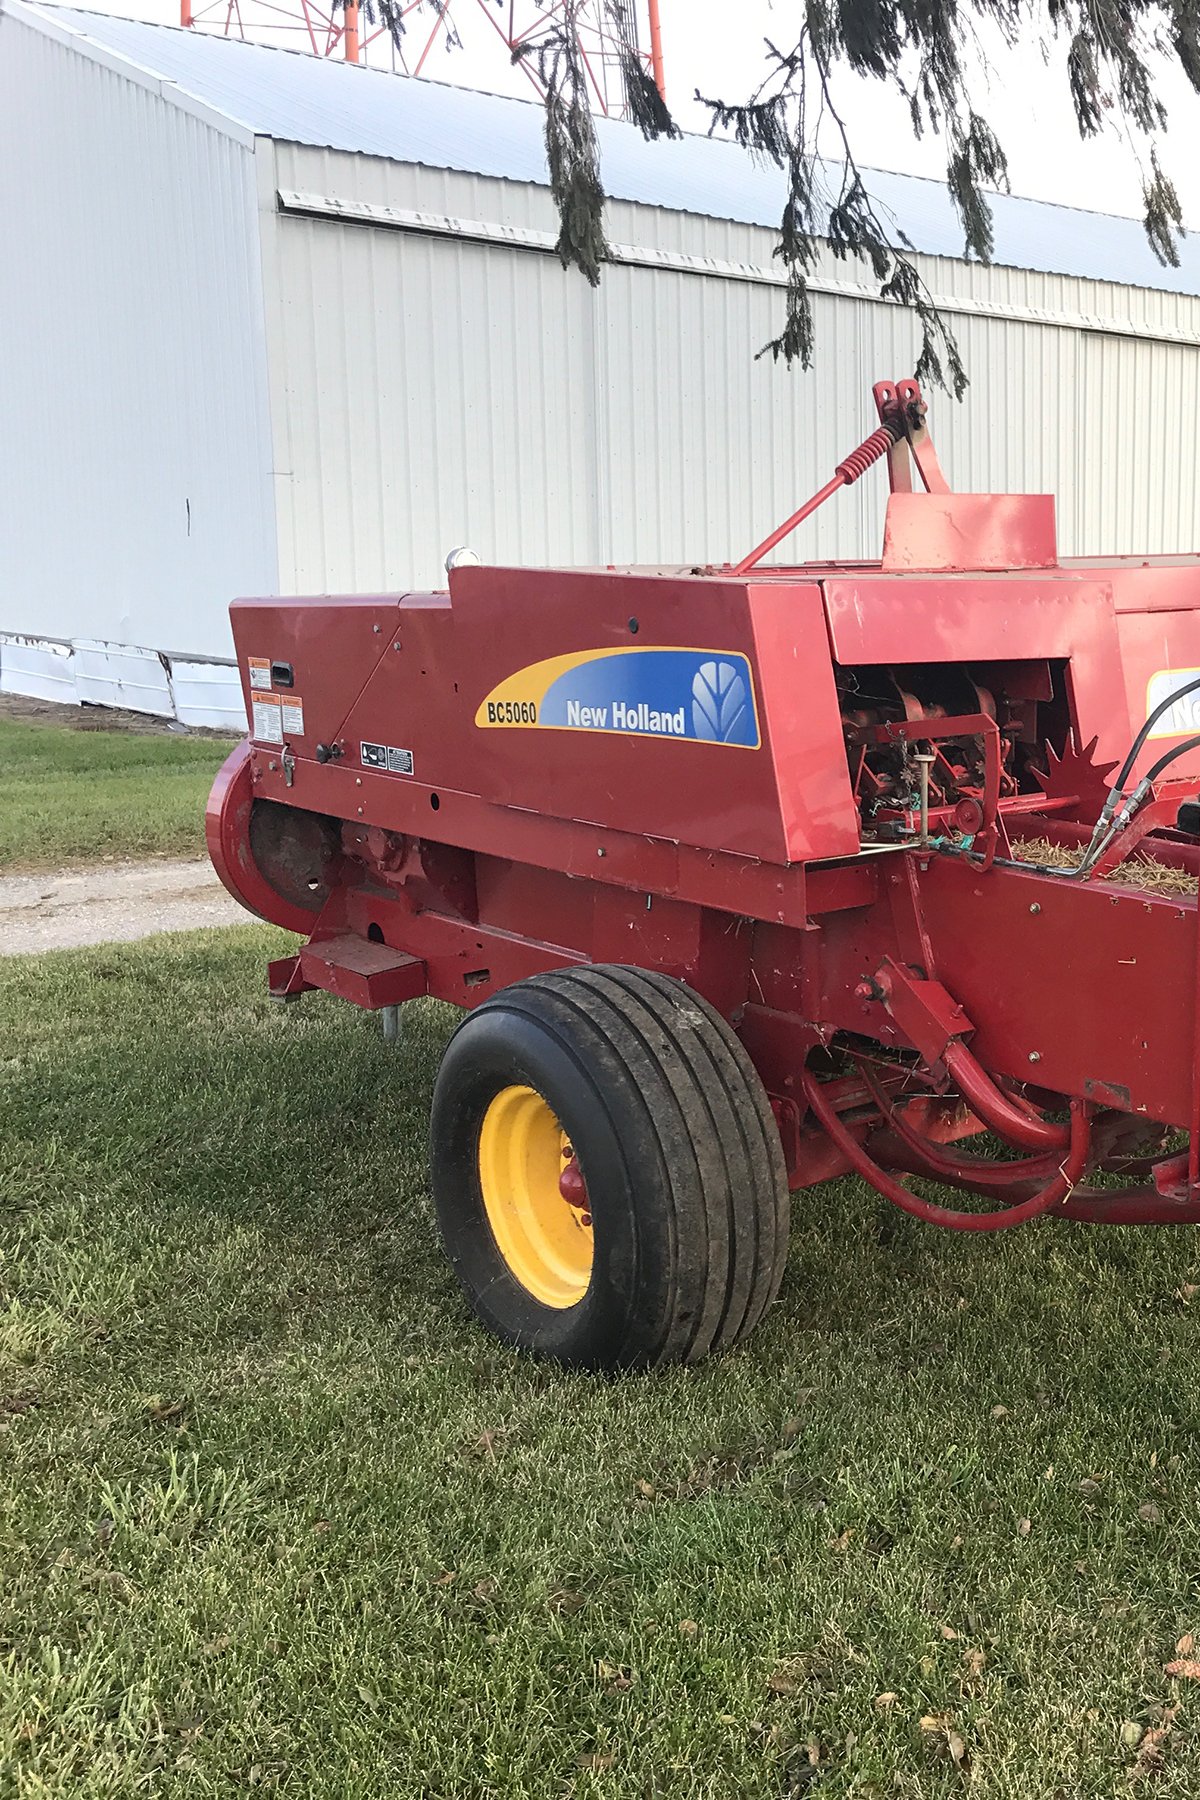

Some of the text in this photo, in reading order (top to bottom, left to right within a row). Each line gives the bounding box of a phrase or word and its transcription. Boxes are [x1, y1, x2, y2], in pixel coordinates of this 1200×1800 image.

[487, 701, 537, 724] BC5060
[566, 700, 686, 735] New Holland
